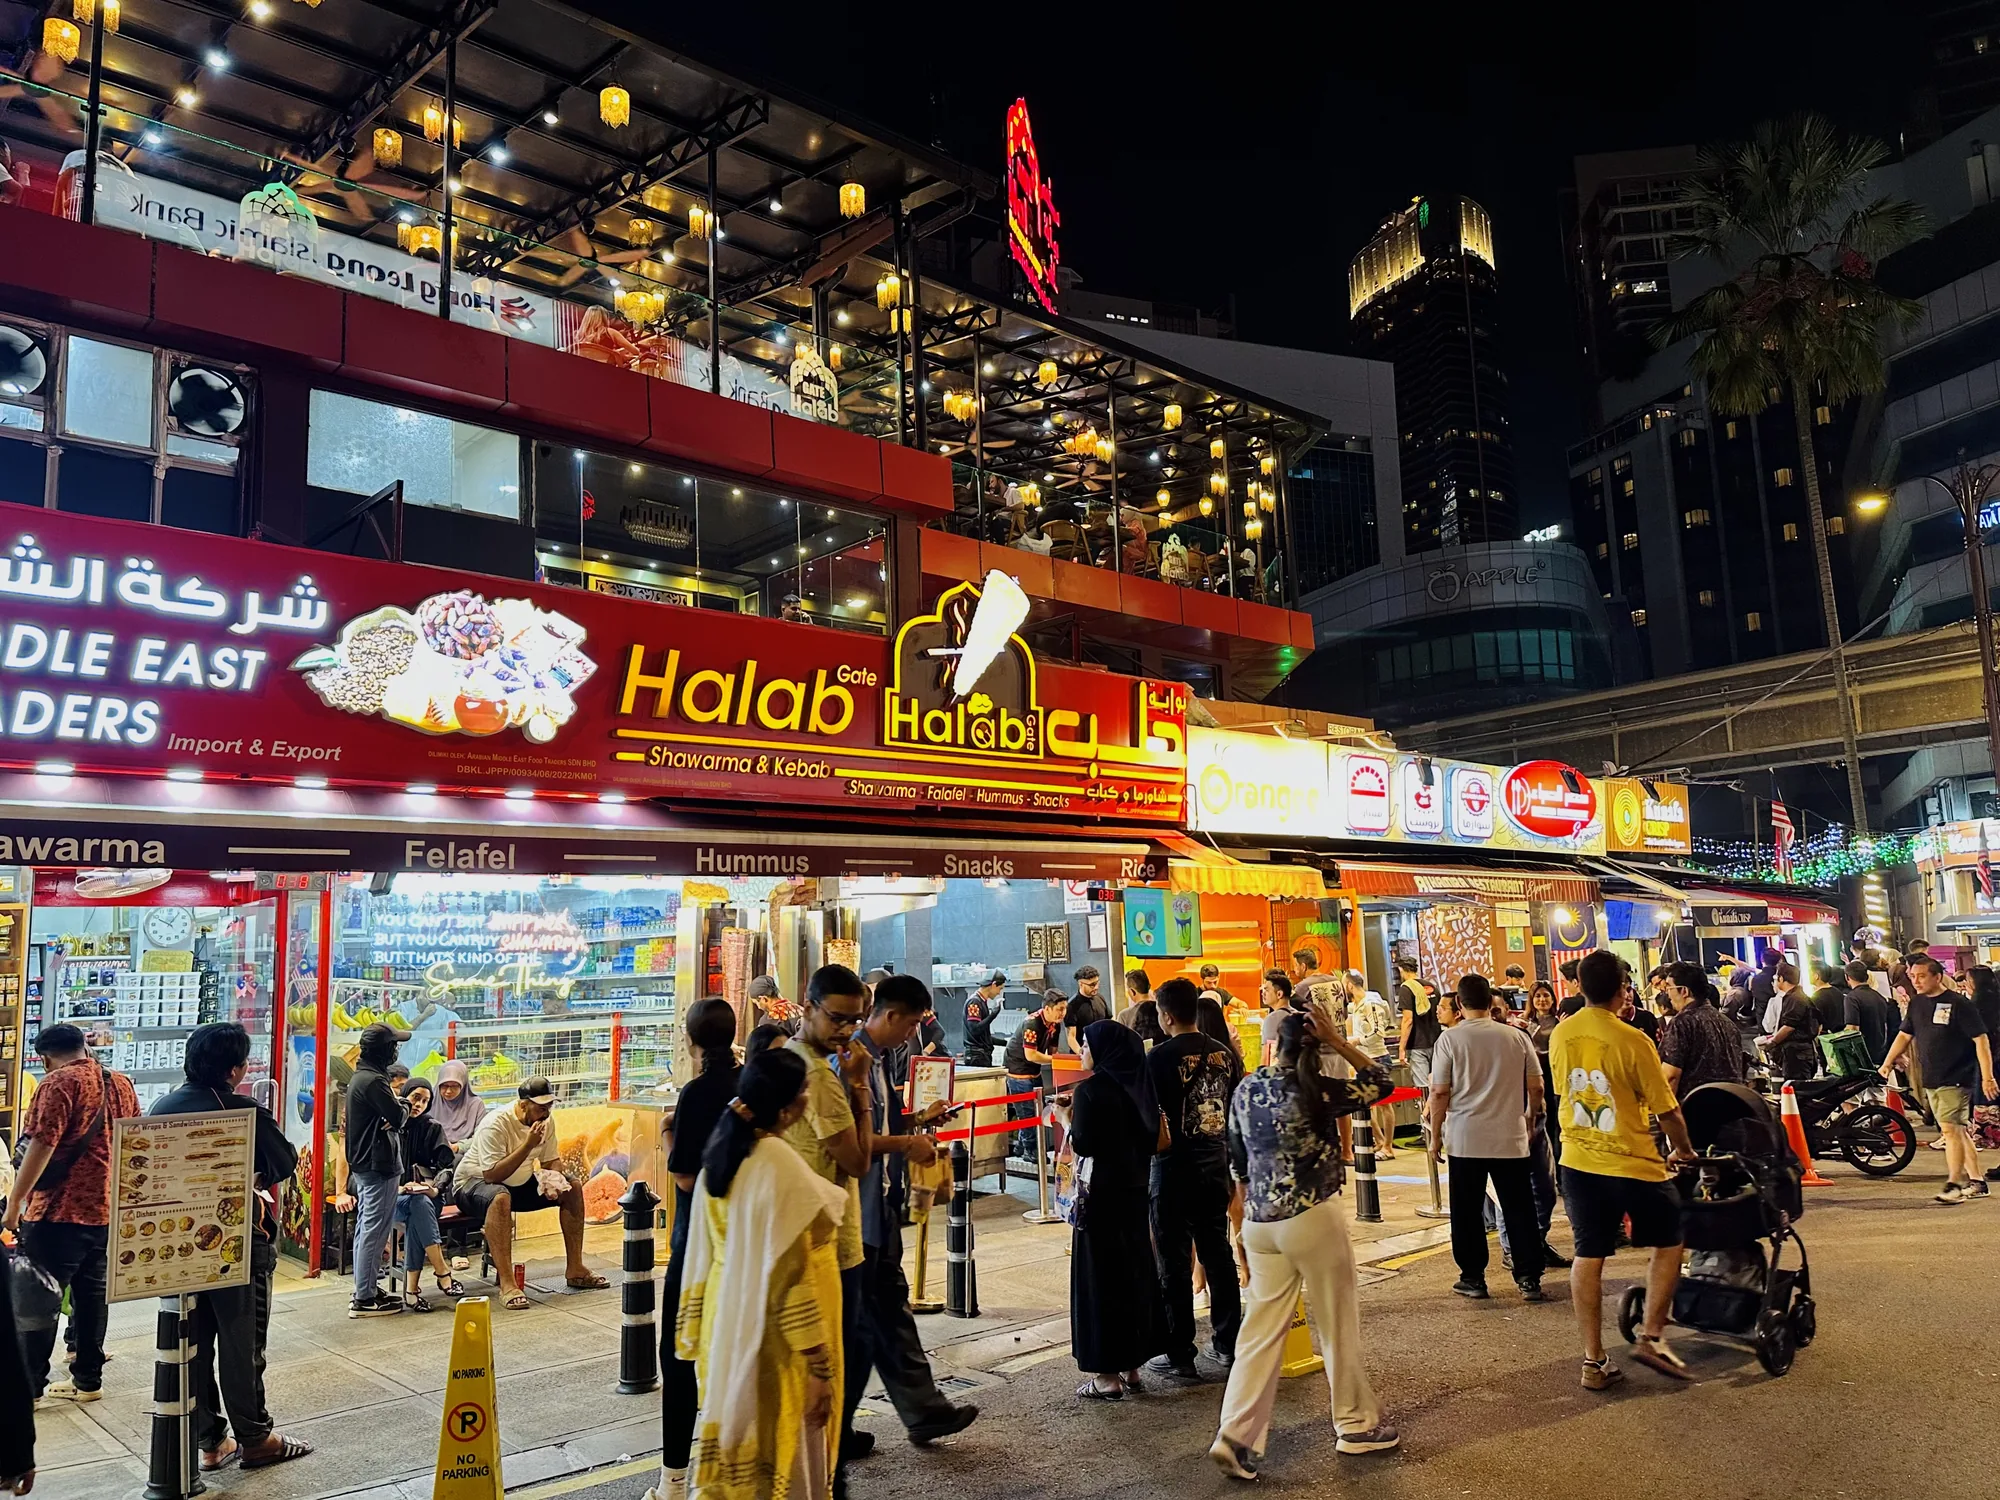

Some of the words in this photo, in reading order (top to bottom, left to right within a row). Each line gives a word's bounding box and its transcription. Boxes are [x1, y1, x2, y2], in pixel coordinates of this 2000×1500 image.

[802, 381, 826, 400] GATE
[1463, 566, 1539, 588] APPLE
[117, 555, 328, 636] شركة
[0, 623, 115, 678] DLE
[132, 637, 267, 691] EAST
[836, 664, 878, 687] Gate
[618, 643, 854, 736] Halab
[1148, 682, 1187, 716] بوابة
[0, 689, 162, 744] DERS
[891, 695, 1027, 750] Halab
[1026, 714, 1036, 751] Gate
[167, 732, 244, 757] Import
[249, 738, 265, 756] &
[270, 739, 342, 763] Export
[567, 758, 581, 767] SDN
[582, 759, 597, 768] BHD
[649, 745, 752, 773] Shawarma
[756, 757, 769, 774] &
[774, 755, 832, 779] Kebab
[849, 779, 916, 799] Shawarma
[927, 785, 966, 801] Falafel
[977, 788, 1024, 805] Hummus
[1033, 792, 1070, 808] Snacks
[1086, 782, 1119, 802] كباب
[1133, 785, 1168, 805] شاورما
[0, 834, 165, 864] awarma
[403, 839, 517, 872] Felafel
[695, 846, 810, 875] Hummus
[943, 852, 1015, 877] Snacks
[1120, 857, 1156, 880] Rice
[1098, 890, 1115, 901] 038
[373, 912, 407, 927] YOU
[373, 932, 405, 946] BUT
[406, 932, 438, 947] YOU
[372, 951, 405, 965] BUT
[457, 952, 493, 965] KIND
[494, 952, 514, 965] OF
[424, 961, 503, 1000] Same
[499, 962, 576, 999] Thing
[141, 1122, 162, 1131] Wraps
[169, 1119, 204, 1129] Sandwiches
[136, 1210, 157, 1219] Dishes
[452, 1369, 461, 1380] NO
[461, 1367, 486, 1379] PARKING
[460, 1411, 478, 1434] P
[456, 1453, 476, 1465] NO
[442, 1465, 490, 1481] PARKING
